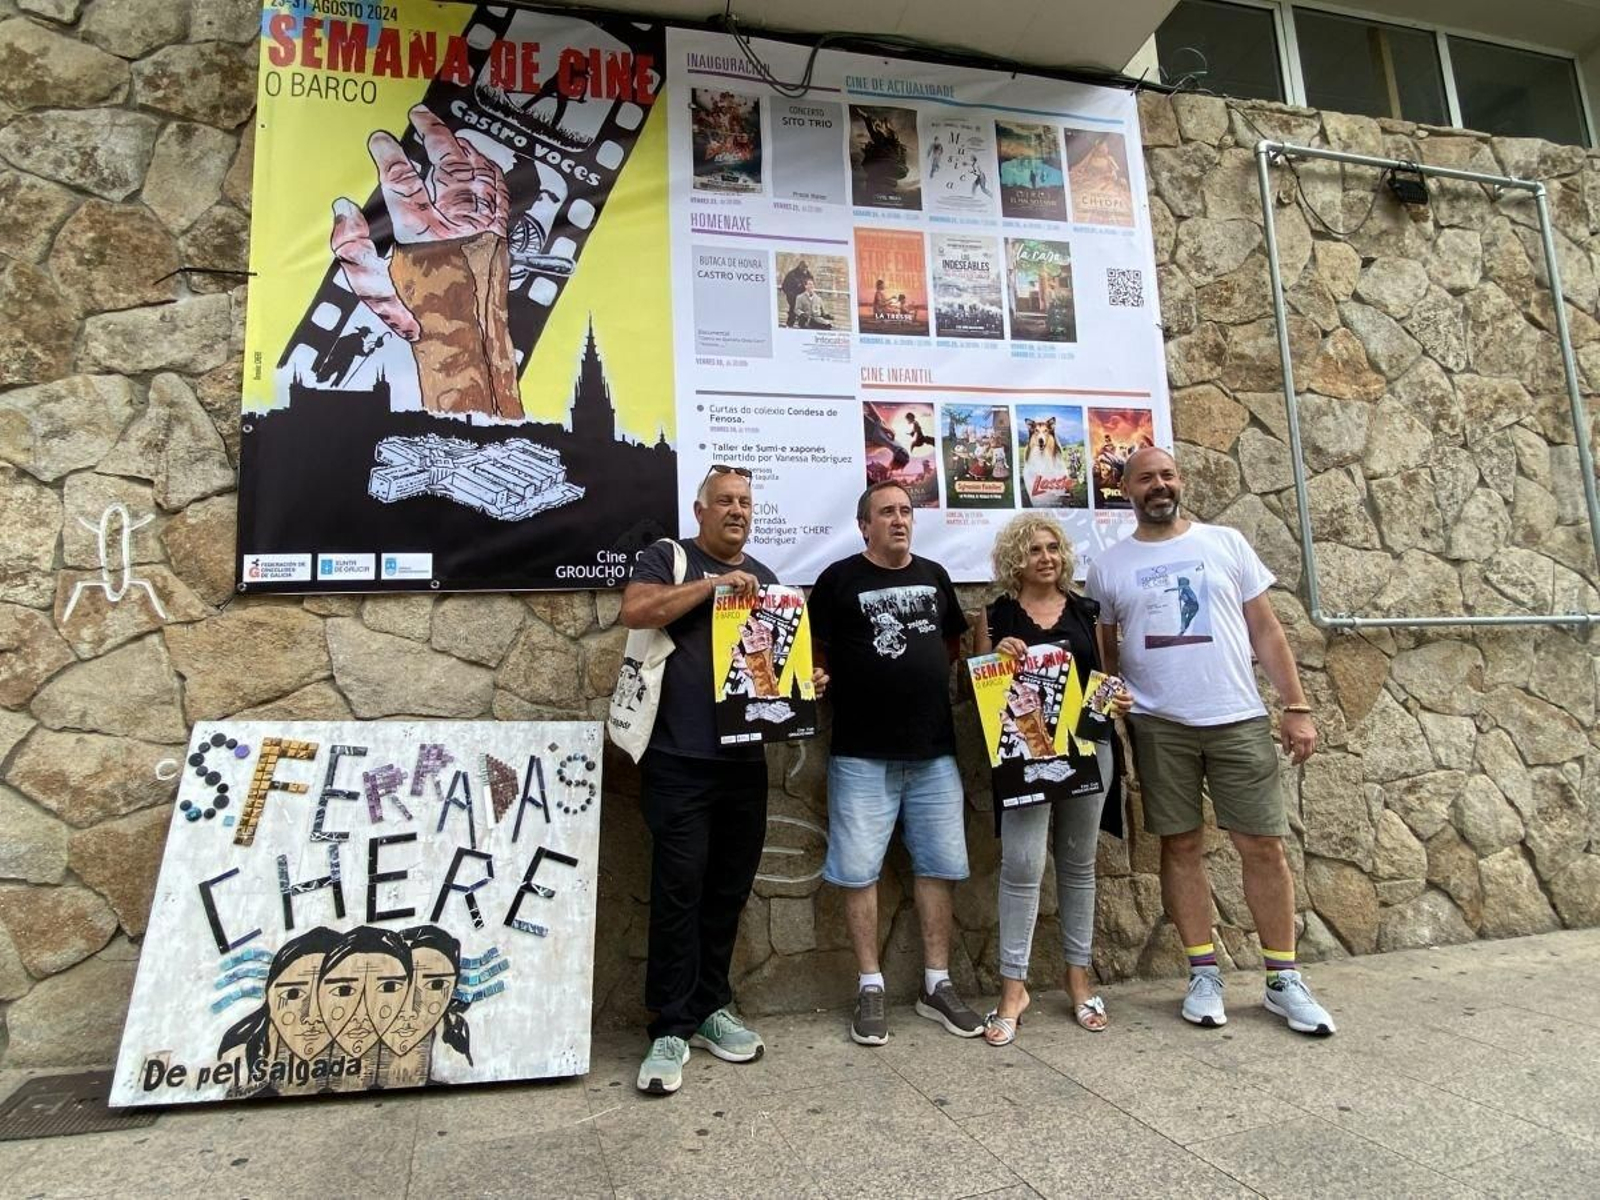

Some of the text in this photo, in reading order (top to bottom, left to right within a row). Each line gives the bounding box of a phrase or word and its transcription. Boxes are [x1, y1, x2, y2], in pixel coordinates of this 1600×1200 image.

[312, 0, 363, 18] AGOSTO
[367, 5, 397, 21] 2024
[268, 14, 656, 105] SEMANA DE CINE
[265, 71, 377, 104] O BARCO
[846, 75, 955, 98] CINE DE ACTUALIDADE
[789, 105, 825, 117] CONCERTO
[781, 116, 833, 128] SITO TRIO
[690, 212, 752, 232] HOMENAXE
[699, 255, 762, 269] BUTACA DE HONRA
[942, 259, 990, 272] INDESEABLES
[697, 270, 766, 282] CASTRO VOCES
[860, 366, 933, 383] CINE INFANTIL
[709, 404, 838, 417] Curtas do colexio Condesa de
[709, 414, 745, 424] Fenosa.
[712, 443, 826, 455] Taller de Sumi-e xaponés
[712, 452, 756, 463] Impartido
[758, 455, 773, 464] por
[775, 454, 809, 463] Vanessa
[753, 516, 786, 525] erradas
[596, 550, 627, 563] Cine
[555, 565, 625, 578] GROUCHO
[973, 658, 1024, 681] SEMANA
[198, 832, 579, 955] CHERE
[143, 1058, 187, 1092] De
[196, 1057, 241, 1091] pel
